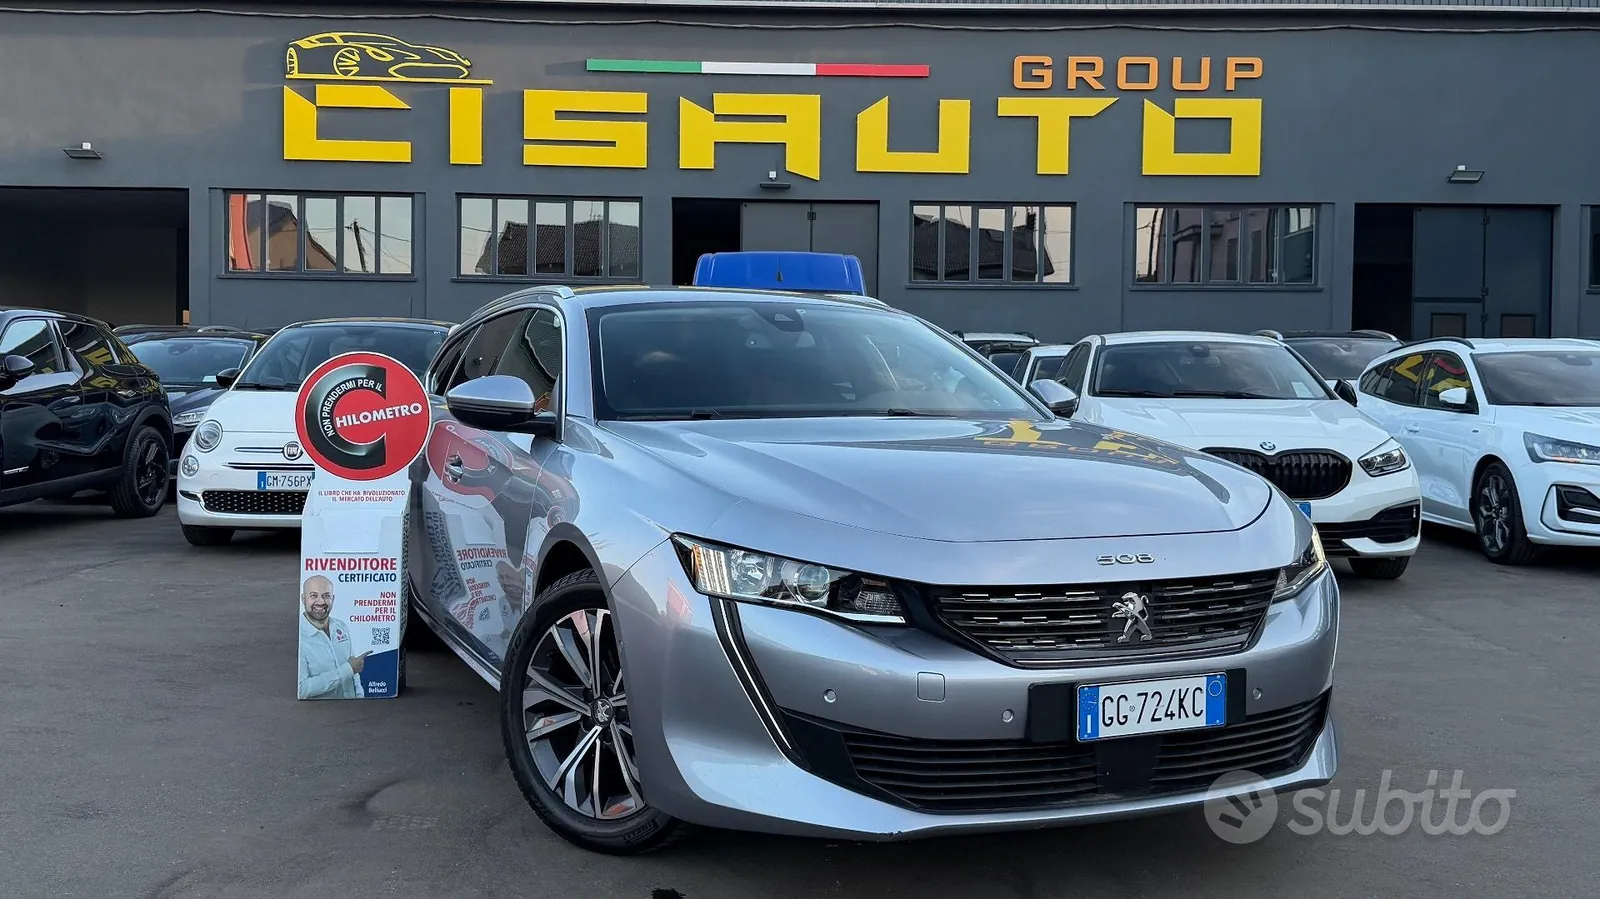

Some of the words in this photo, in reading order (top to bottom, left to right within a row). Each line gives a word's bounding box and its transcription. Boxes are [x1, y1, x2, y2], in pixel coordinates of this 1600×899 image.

[1013, 55, 1264, 91] GROUP
[284, 84, 1262, 181] CISAUTO
[357, 379, 375, 389] PER
[375, 382, 383, 392] IL
[322, 380, 356, 417] PRENDERMI
[322, 419, 335, 437] NON
[305, 557, 397, 571] RIVENDITORE
[1096, 552, 1155, 566] 508
[338, 573, 397, 583] CERTIFICATO
[380, 591, 397, 599] NON
[354, 599, 396, 607] PRENDERMI
[349, 614, 396, 623] CHILOMETRO
